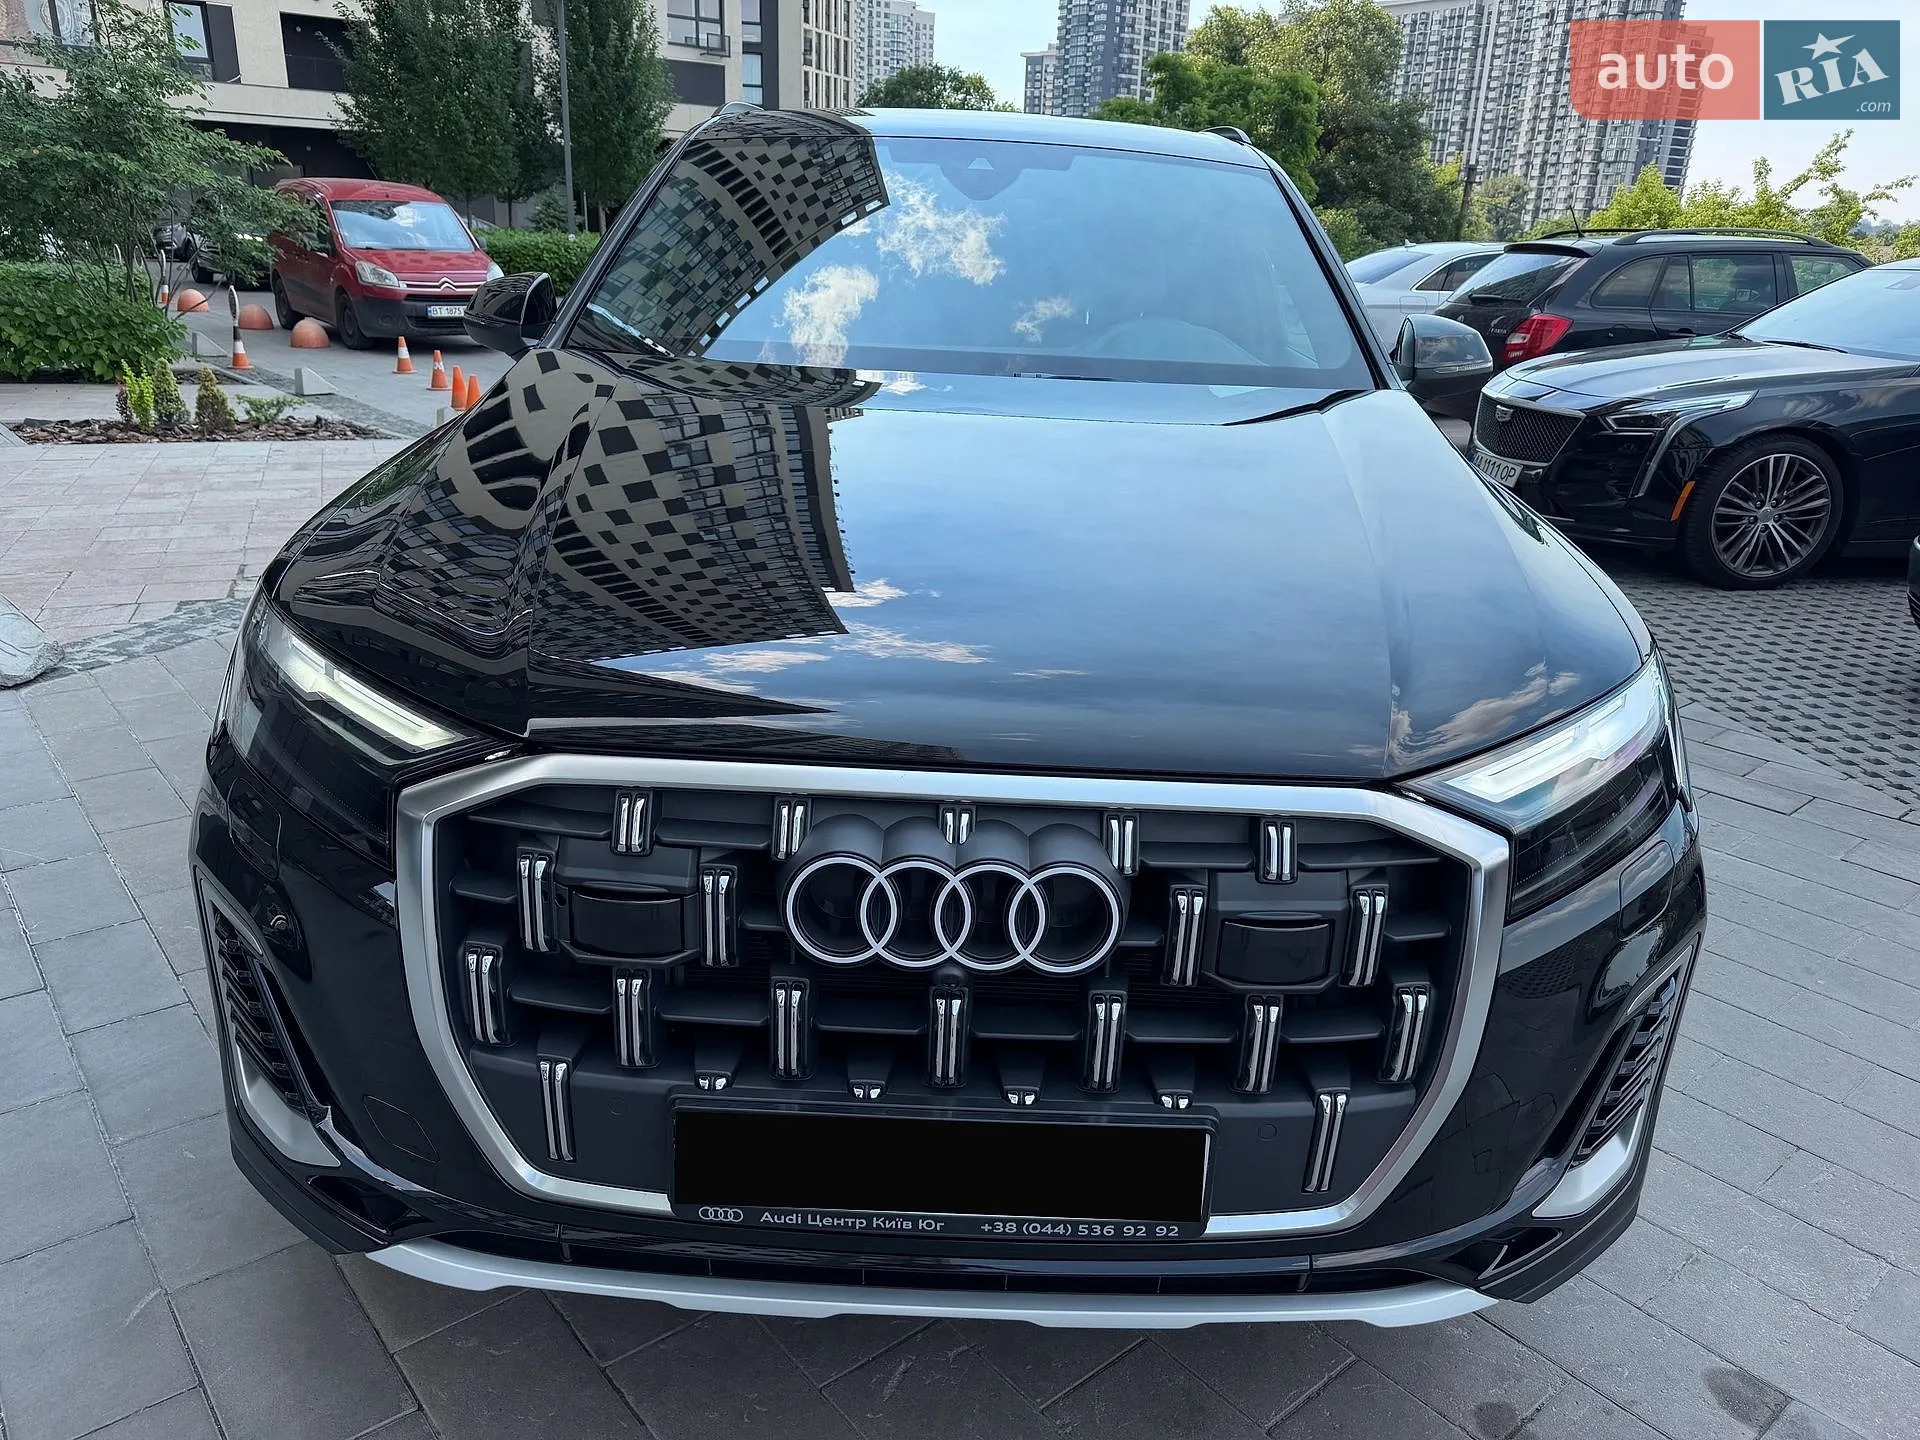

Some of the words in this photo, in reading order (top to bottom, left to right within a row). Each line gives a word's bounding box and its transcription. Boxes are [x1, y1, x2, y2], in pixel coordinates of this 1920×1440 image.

[759, 1211, 802, 1225] Audi
[807, 1213, 867, 1230] Центр
[872, 1216, 913, 1229] Київ
[918, 1218, 945, 1231] Юг
[980, 1221, 1018, 1233] +38
[1022, 1222, 1072, 1236] (044)
[1077, 1224, 1115, 1237] 536
[1123, 1225, 1147, 1237] 92
[1155, 1225, 1179, 1237] 92
